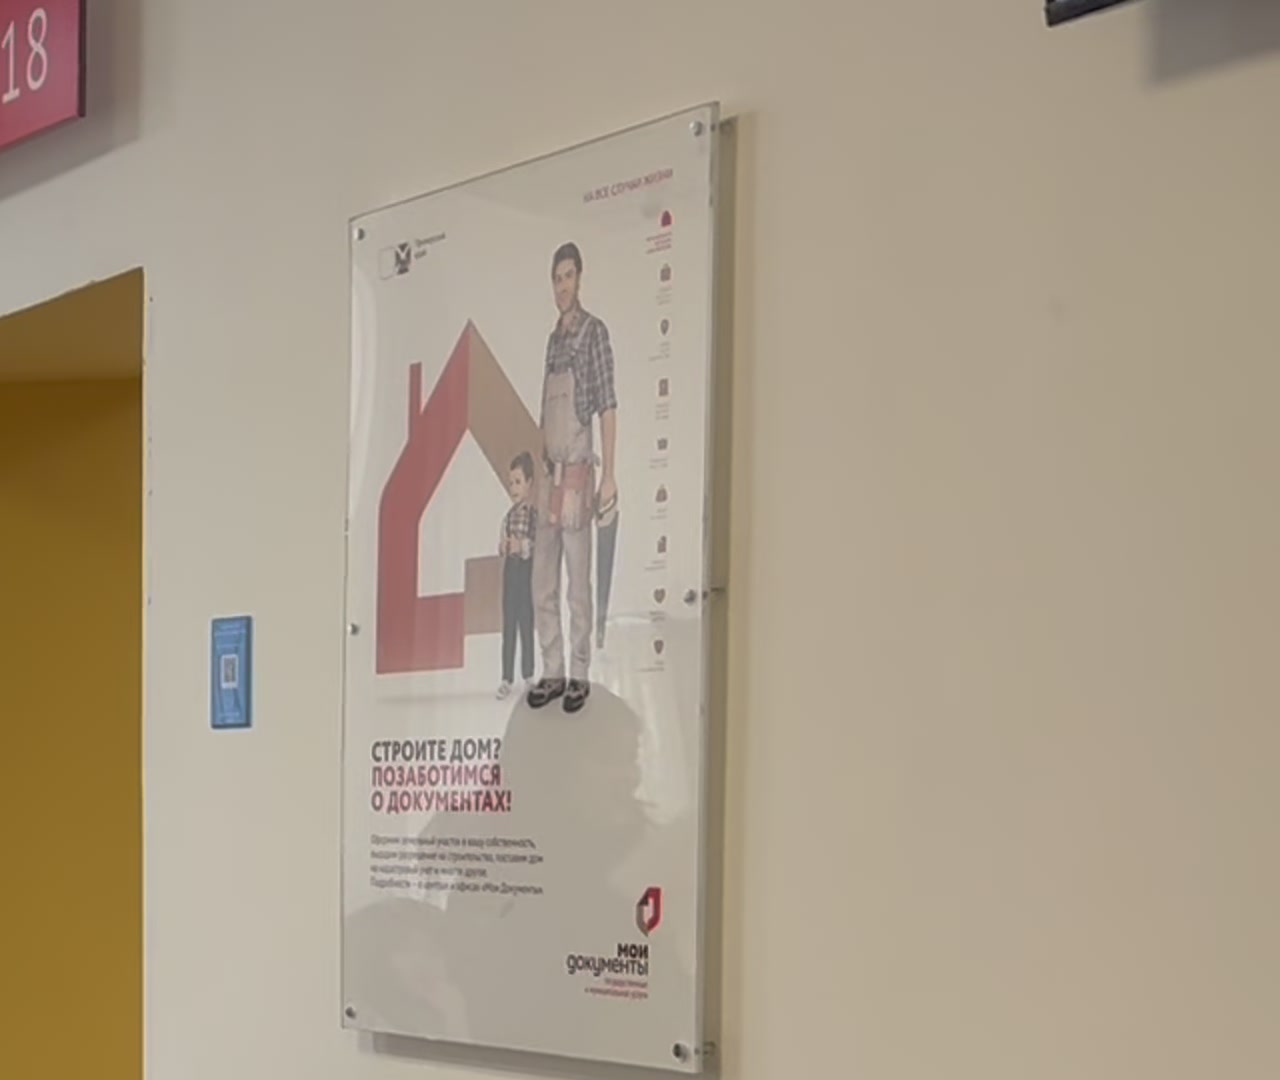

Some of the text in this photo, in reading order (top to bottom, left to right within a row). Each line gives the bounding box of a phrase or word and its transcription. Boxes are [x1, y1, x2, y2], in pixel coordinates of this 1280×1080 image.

[370, 737, 503, 763] СТРОИТЕ ДОМ?
[371, 763, 502, 787] ПОЗАБОТИМСЯ
[370, 789, 513, 815] О ДОКУМЕНТАХ!
